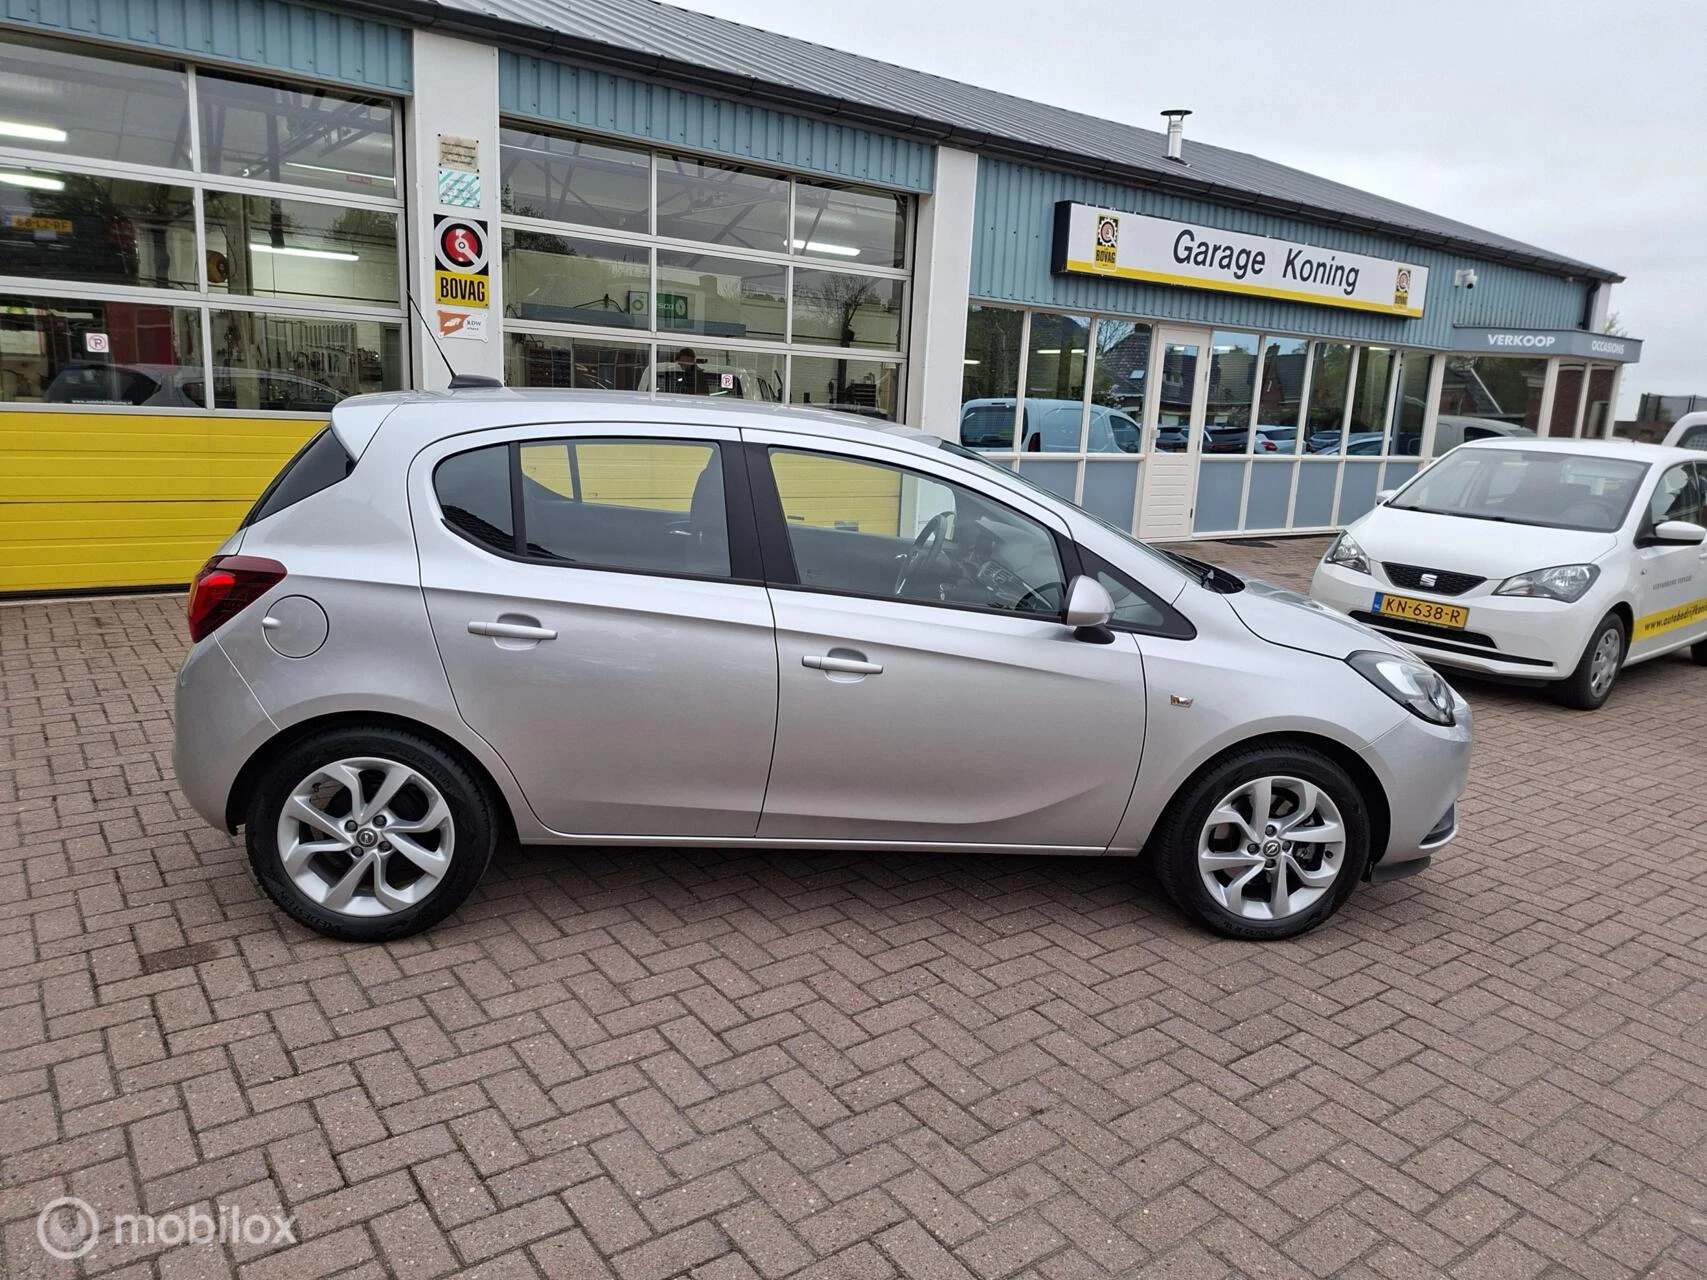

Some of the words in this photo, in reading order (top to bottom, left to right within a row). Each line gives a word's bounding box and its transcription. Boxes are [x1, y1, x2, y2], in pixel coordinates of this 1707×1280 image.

[1096, 249, 1116, 263] BOVAG
[1172, 228, 1266, 280] Garage
[1282, 247, 1360, 296] Koning
[440, 276, 485, 303] BOVAG
[466, 319, 481, 327] RDW
[1487, 333, 1556, 348] VERKOOP
[1385, 597, 1461, 624] KN-638-R
